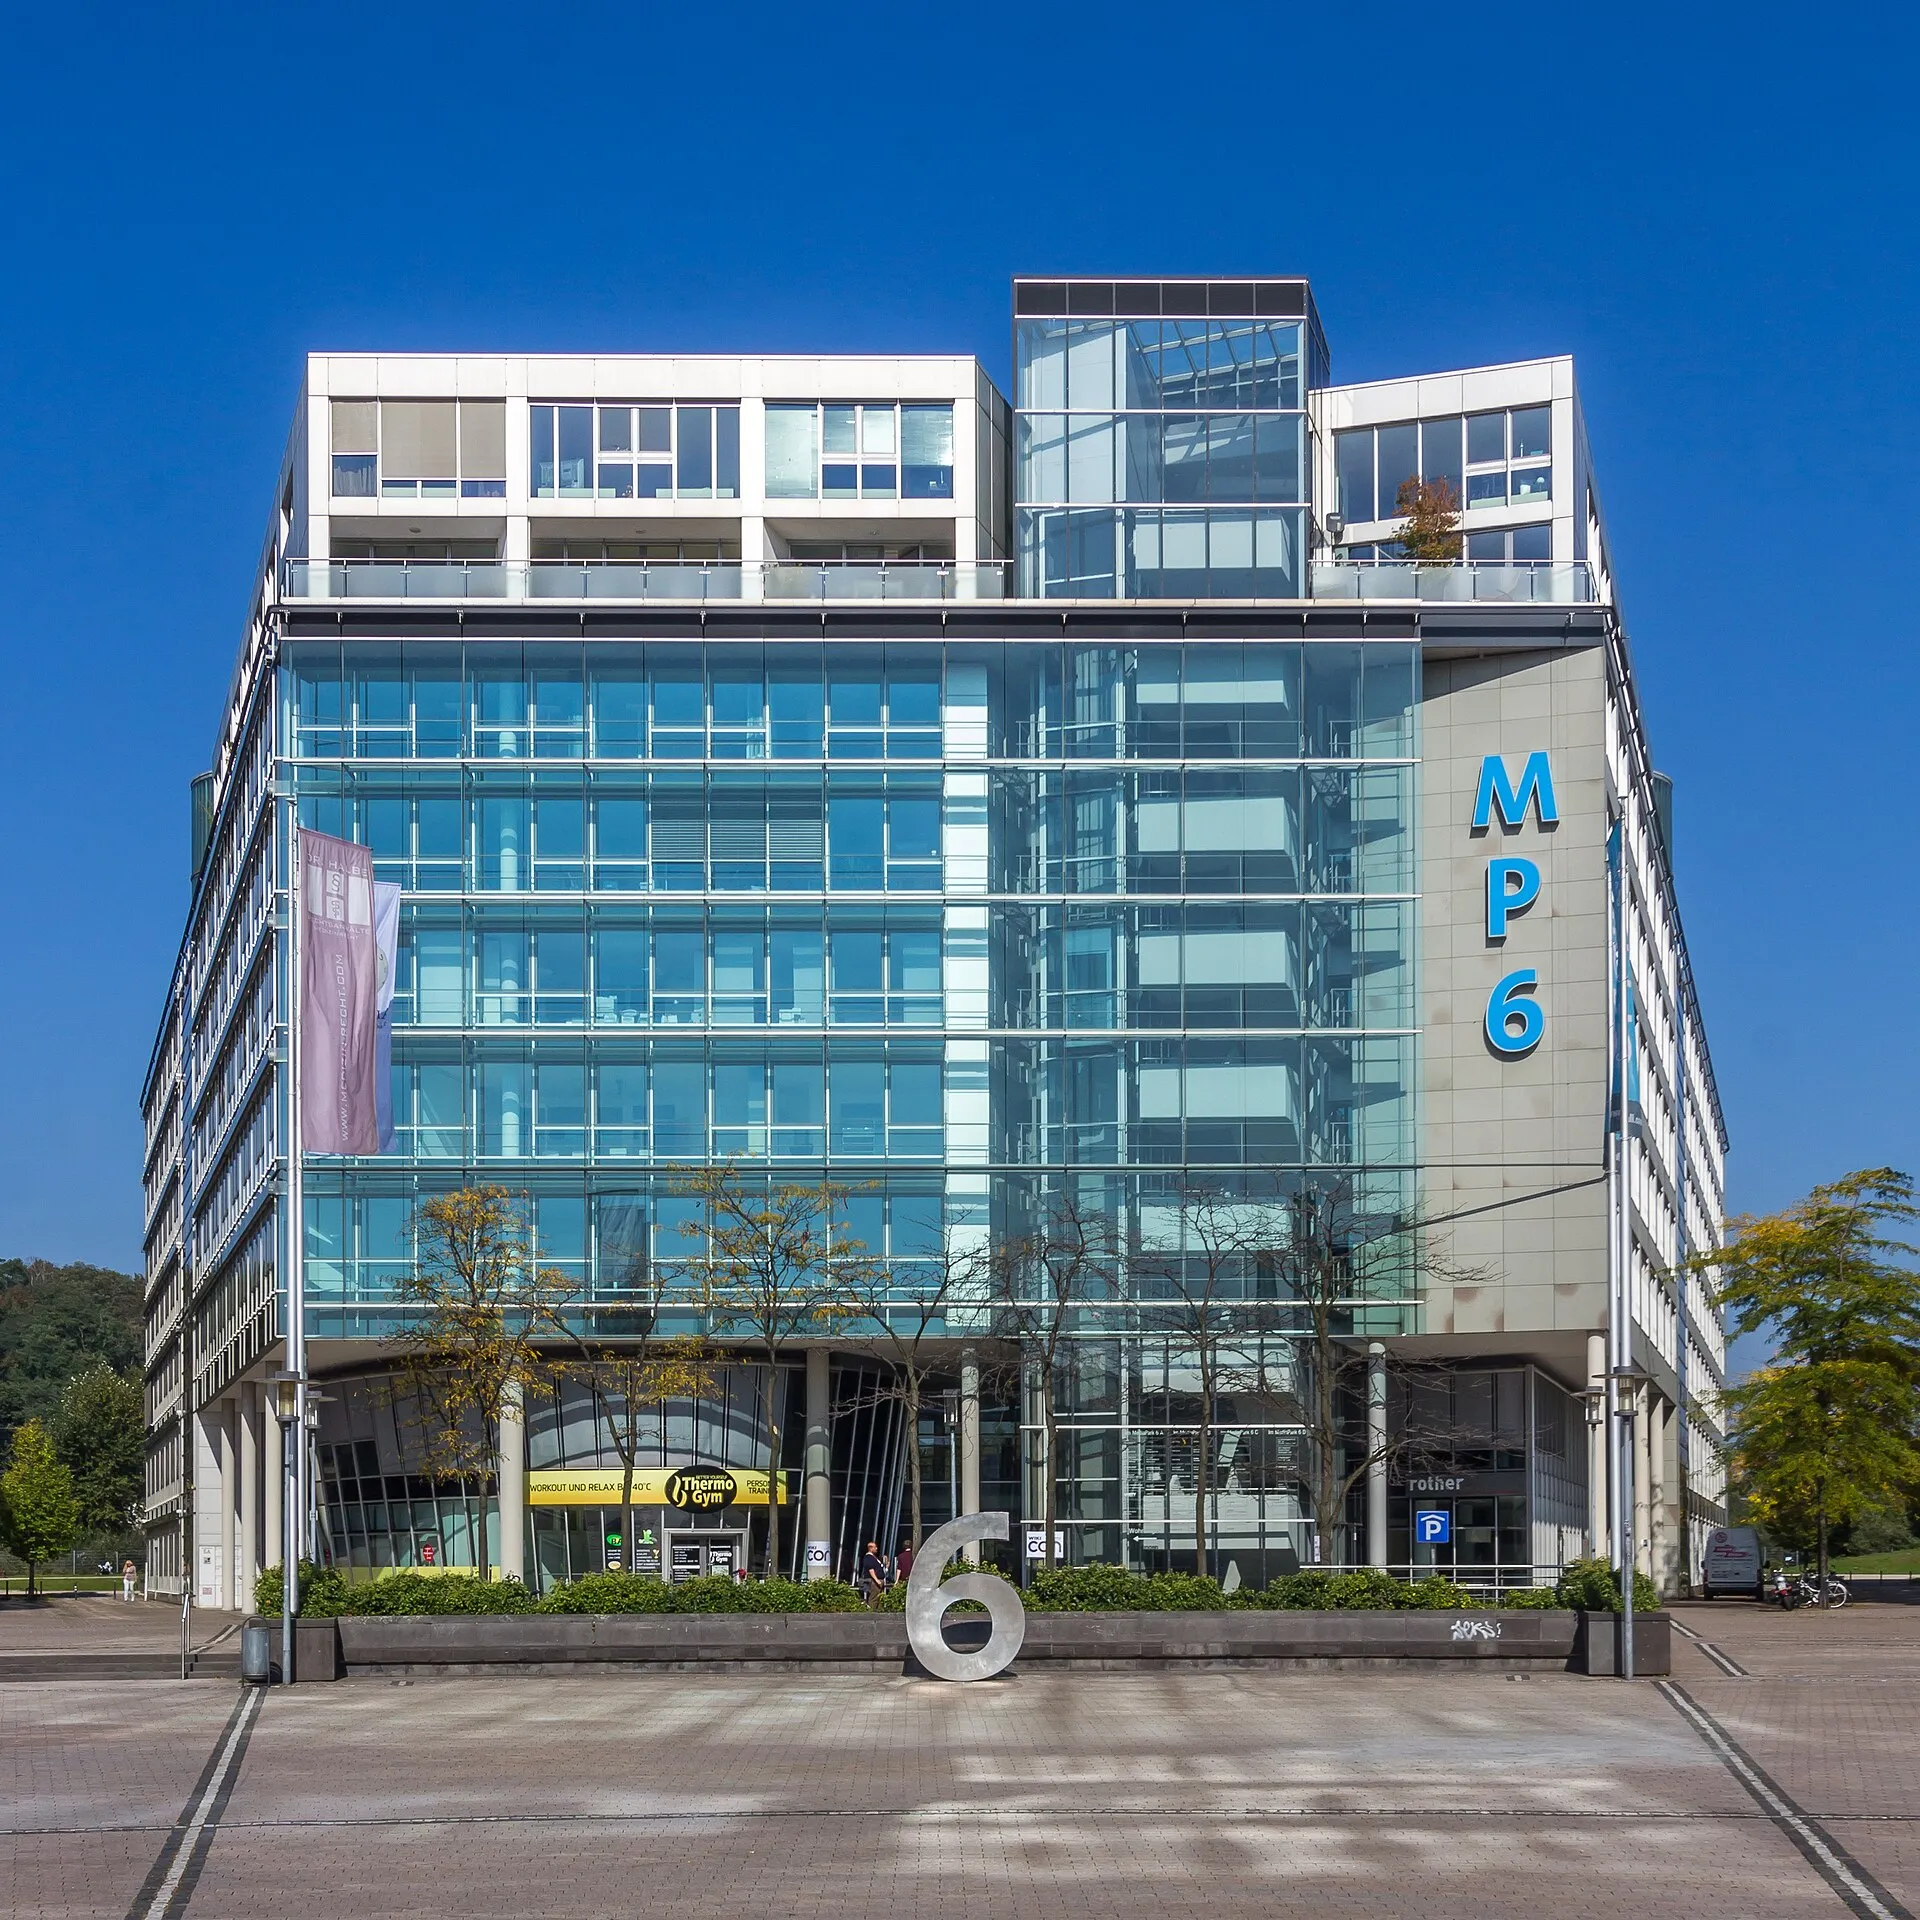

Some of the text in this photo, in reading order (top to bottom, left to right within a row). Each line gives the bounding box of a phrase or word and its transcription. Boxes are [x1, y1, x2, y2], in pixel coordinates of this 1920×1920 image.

[588, 1483, 615, 1491] RELAX
[682, 1477, 734, 1490] Thermo
[1410, 1476, 1464, 1491] rother
[692, 1490, 723, 1507] Gym
[1426, 1520, 1442, 1540] P
[906, 1512, 1026, 1682] 6
